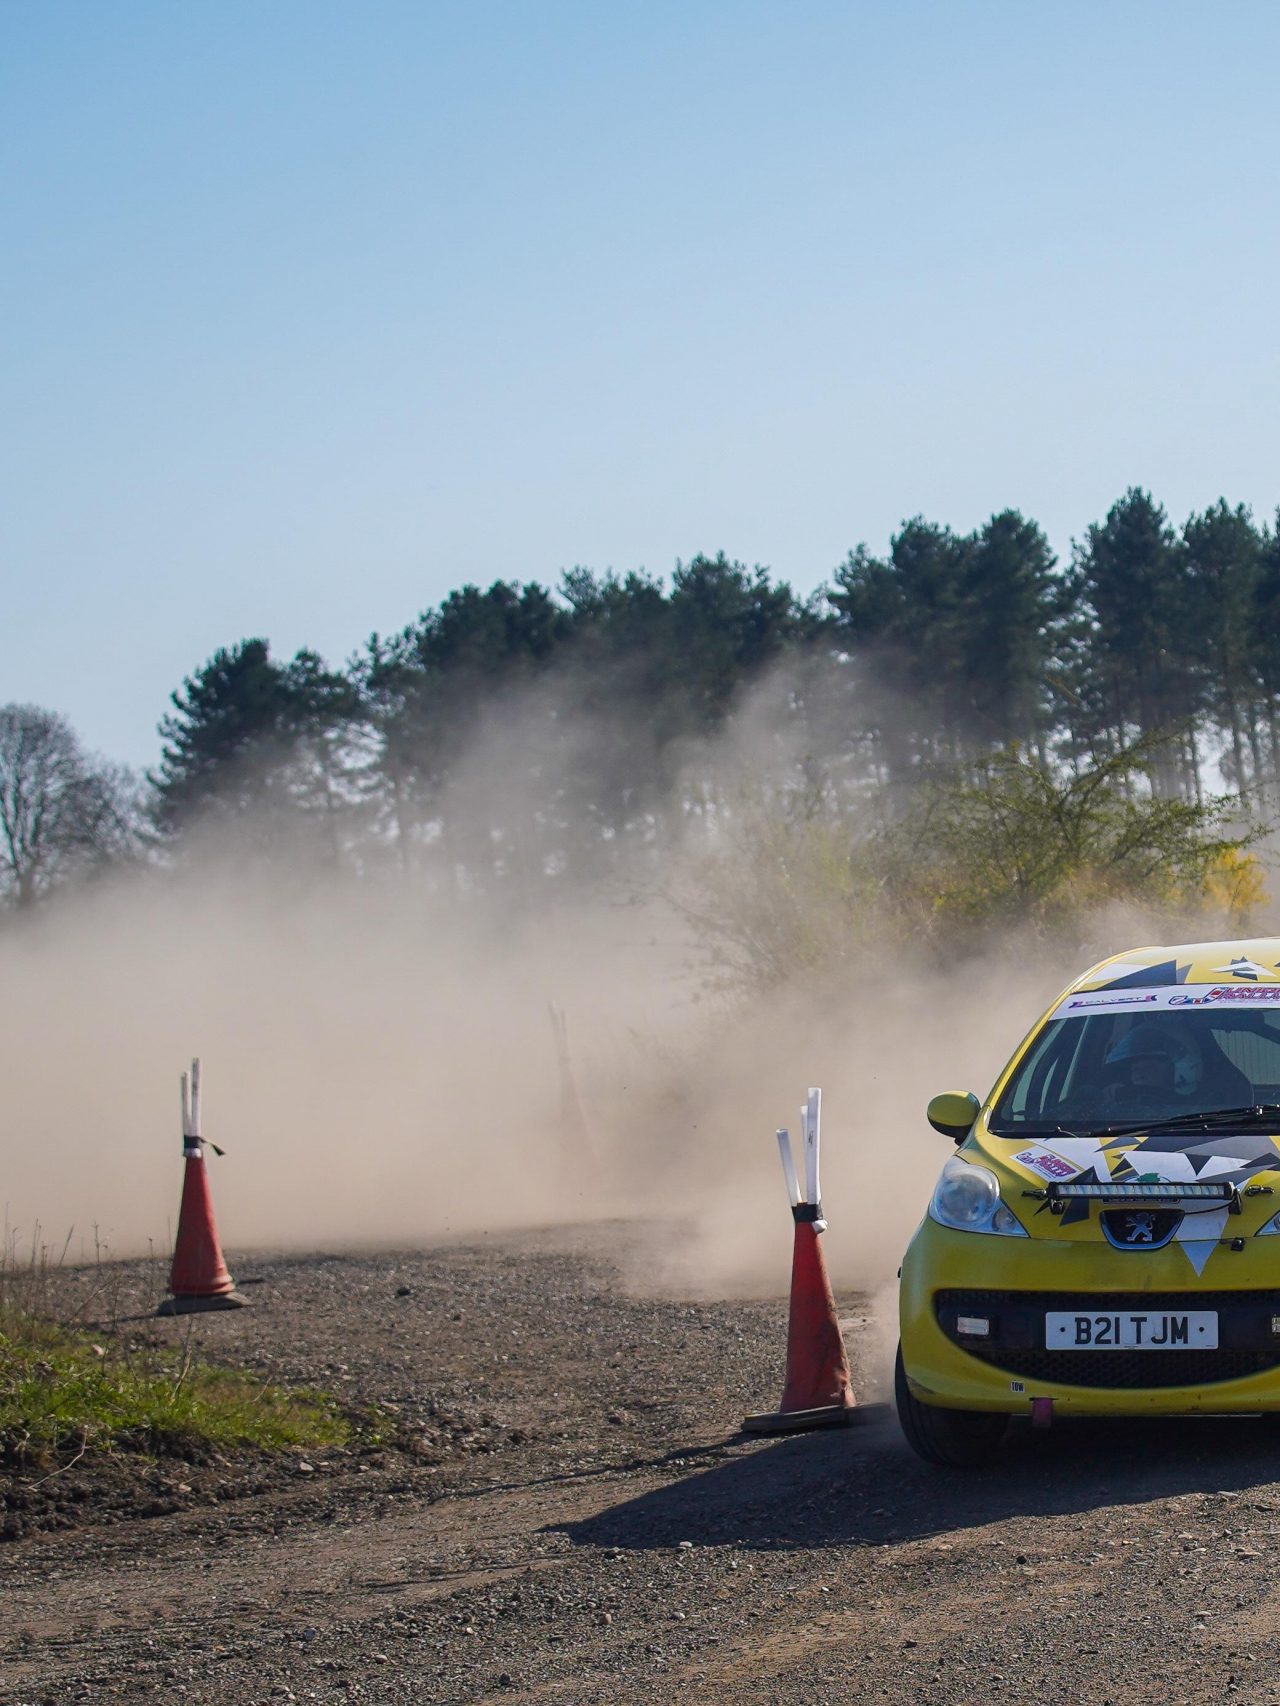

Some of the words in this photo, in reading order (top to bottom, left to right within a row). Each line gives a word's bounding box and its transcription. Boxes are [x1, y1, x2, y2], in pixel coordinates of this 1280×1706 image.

[1086, 996, 1142, 1004] CALVERT
[1075, 1317, 1120, 1344] B21
[1130, 1317, 1188, 1344] TJM
